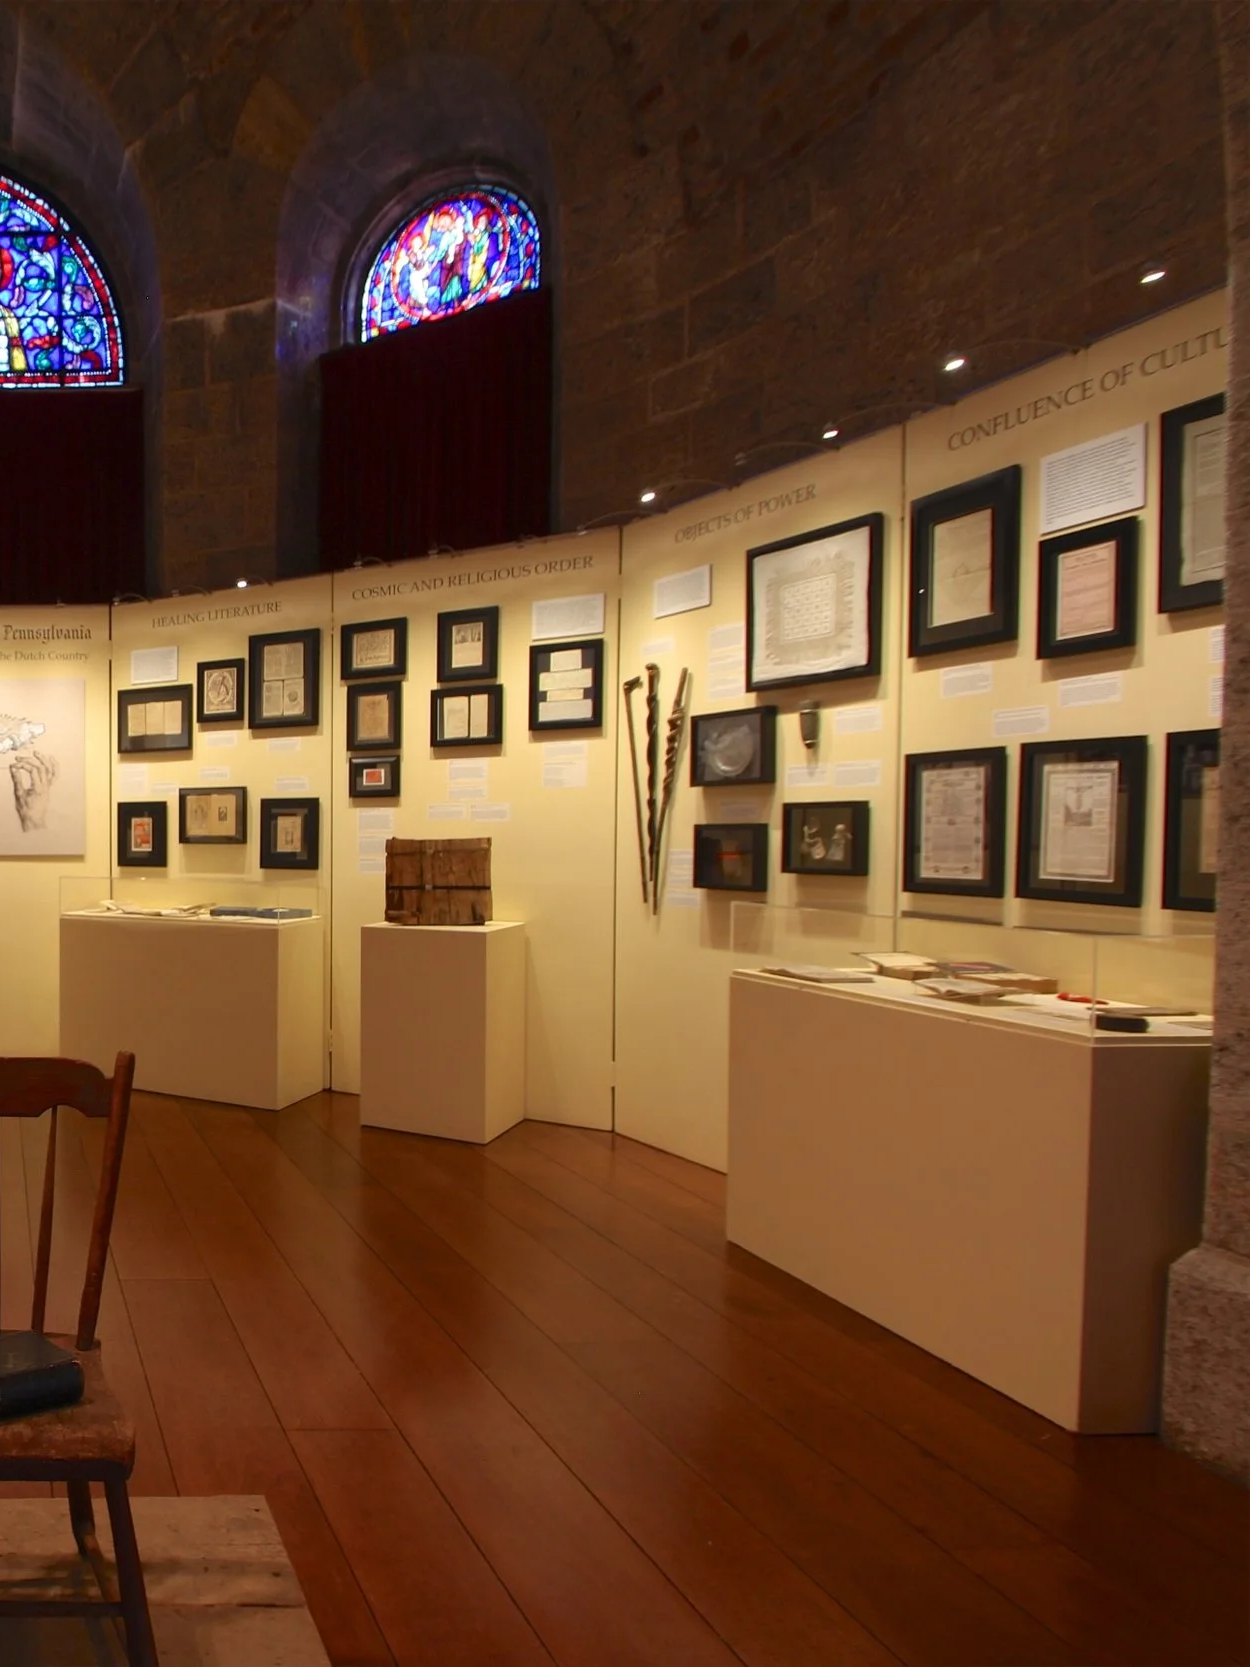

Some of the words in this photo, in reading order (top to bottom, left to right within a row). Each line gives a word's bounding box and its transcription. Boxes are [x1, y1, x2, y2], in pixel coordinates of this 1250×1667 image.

[947, 378, 1096, 451] CONFLUENCE
[1099, 362, 1135, 392] OF
[674, 513, 732, 543] OBJECTS
[734, 504, 755, 523] OF
[757, 483, 817, 517] POWER
[352, 584, 408, 601] COSMIC
[410, 577, 444, 594] AND
[448, 564, 532, 588] RELIGIOUS
[534, 555, 594, 575] ORDER
[152, 612, 205, 628] HEALING
[208, 601, 282, 621] LITERATURE
[3, 624, 92, 644] Pennsylvania
[14, 651, 45, 662] Dutch
[47, 651, 89, 663] Country
